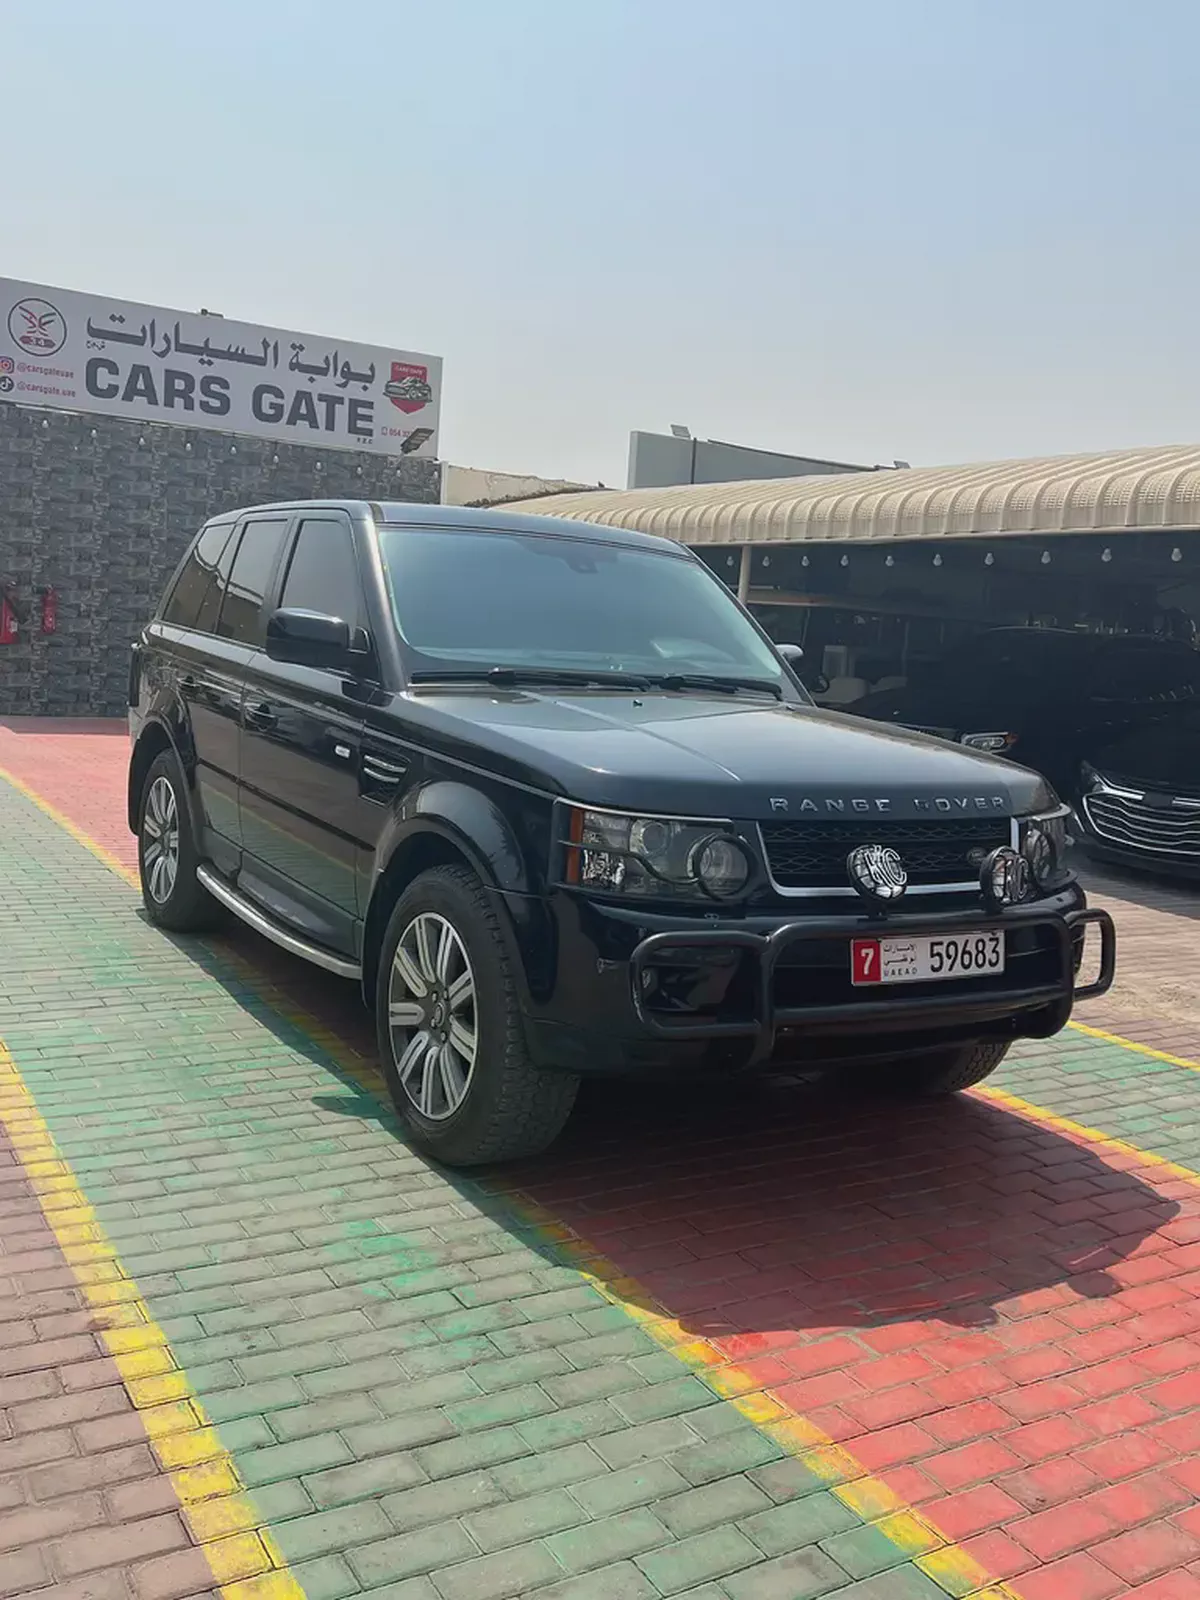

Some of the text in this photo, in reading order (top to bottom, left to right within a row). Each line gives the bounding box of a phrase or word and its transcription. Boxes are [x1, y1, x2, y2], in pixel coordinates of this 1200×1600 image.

[86, 313, 376, 393] بوابة السيارات
[17, 362, 75, 378] @carsgateuae
[17, 381, 77, 397] @carsgate.uae
[85, 356, 375, 438] CARS GATE
[769, 797, 891, 813] RANGE
[860, 937, 1001, 975] 7 59683
